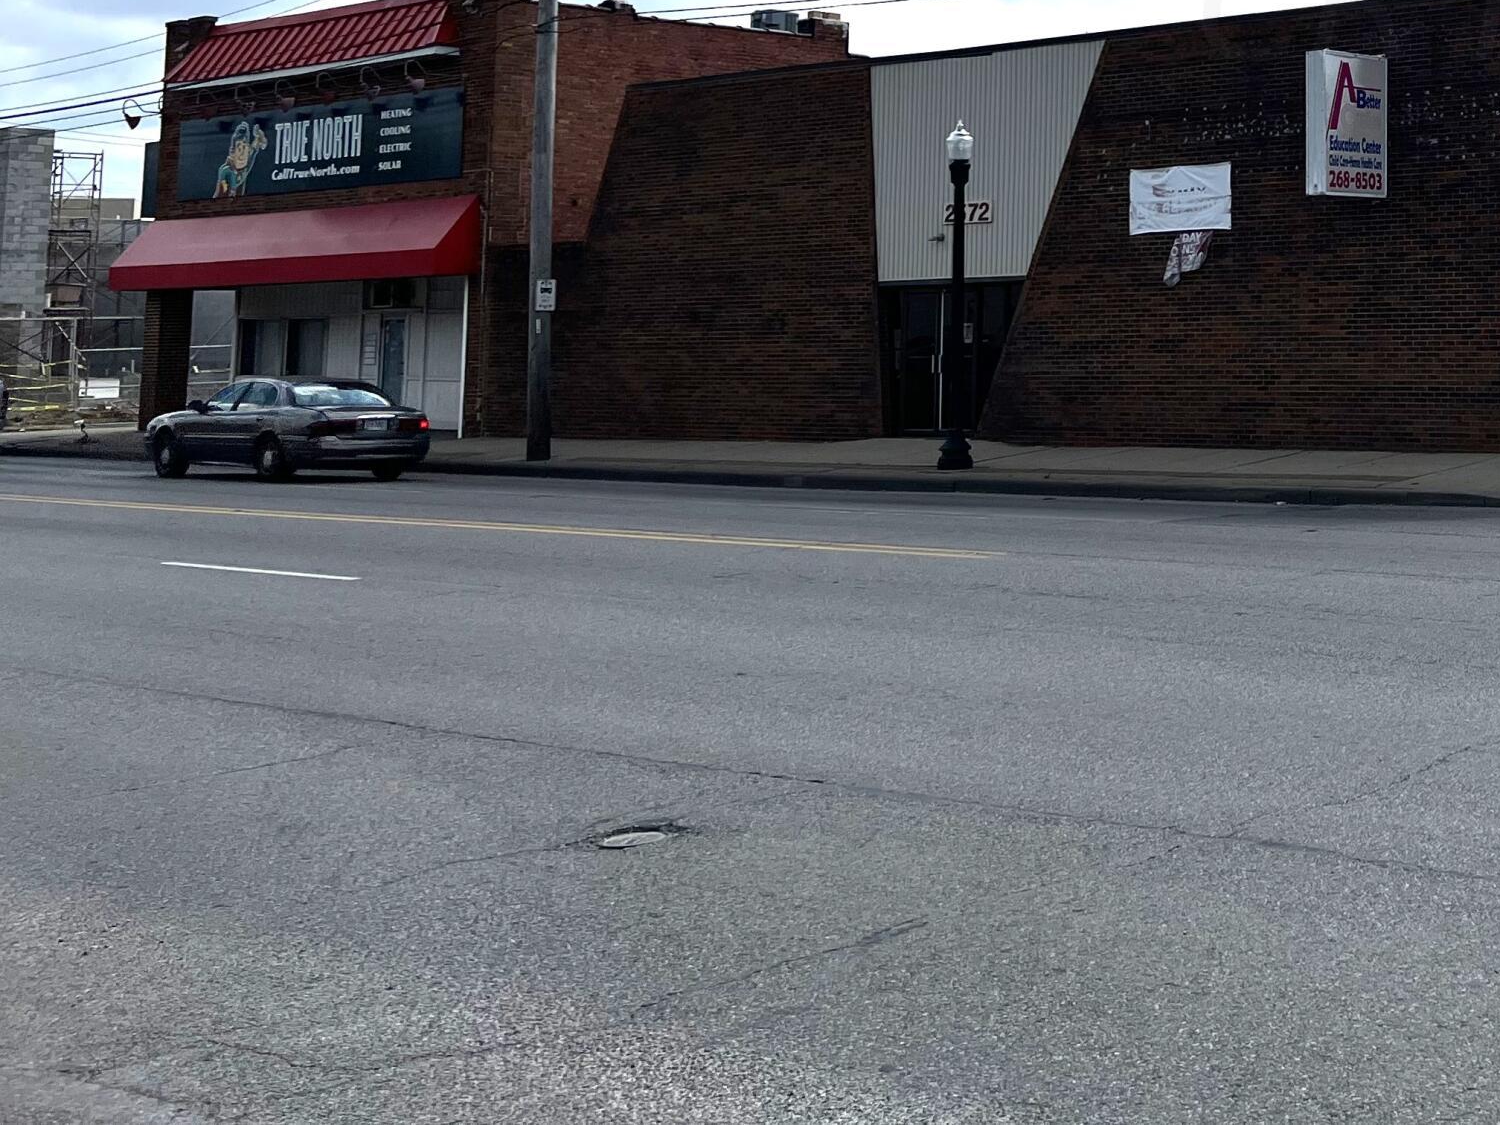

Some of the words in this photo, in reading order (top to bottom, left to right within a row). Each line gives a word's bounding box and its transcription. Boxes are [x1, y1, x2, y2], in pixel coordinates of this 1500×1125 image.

[1327, 61, 1357, 131] A
[1357, 88, 1381, 109] Better
[381, 108, 412, 119] HEATING
[275, 120, 310, 165] TRUE
[312, 114, 363, 161] NORTH
[380, 125, 411, 136] COOLING
[379, 142, 412, 153] ELECTRIC
[1329, 135, 1361, 152] Education
[1362, 137, 1382, 155] Center
[271, 164, 360, 181] CallTrueNorth.com
[378, 160, 401, 171] SOLAR
[1329, 170, 1382, 190] 268-8503
[944, 202, 990, 223] 272
